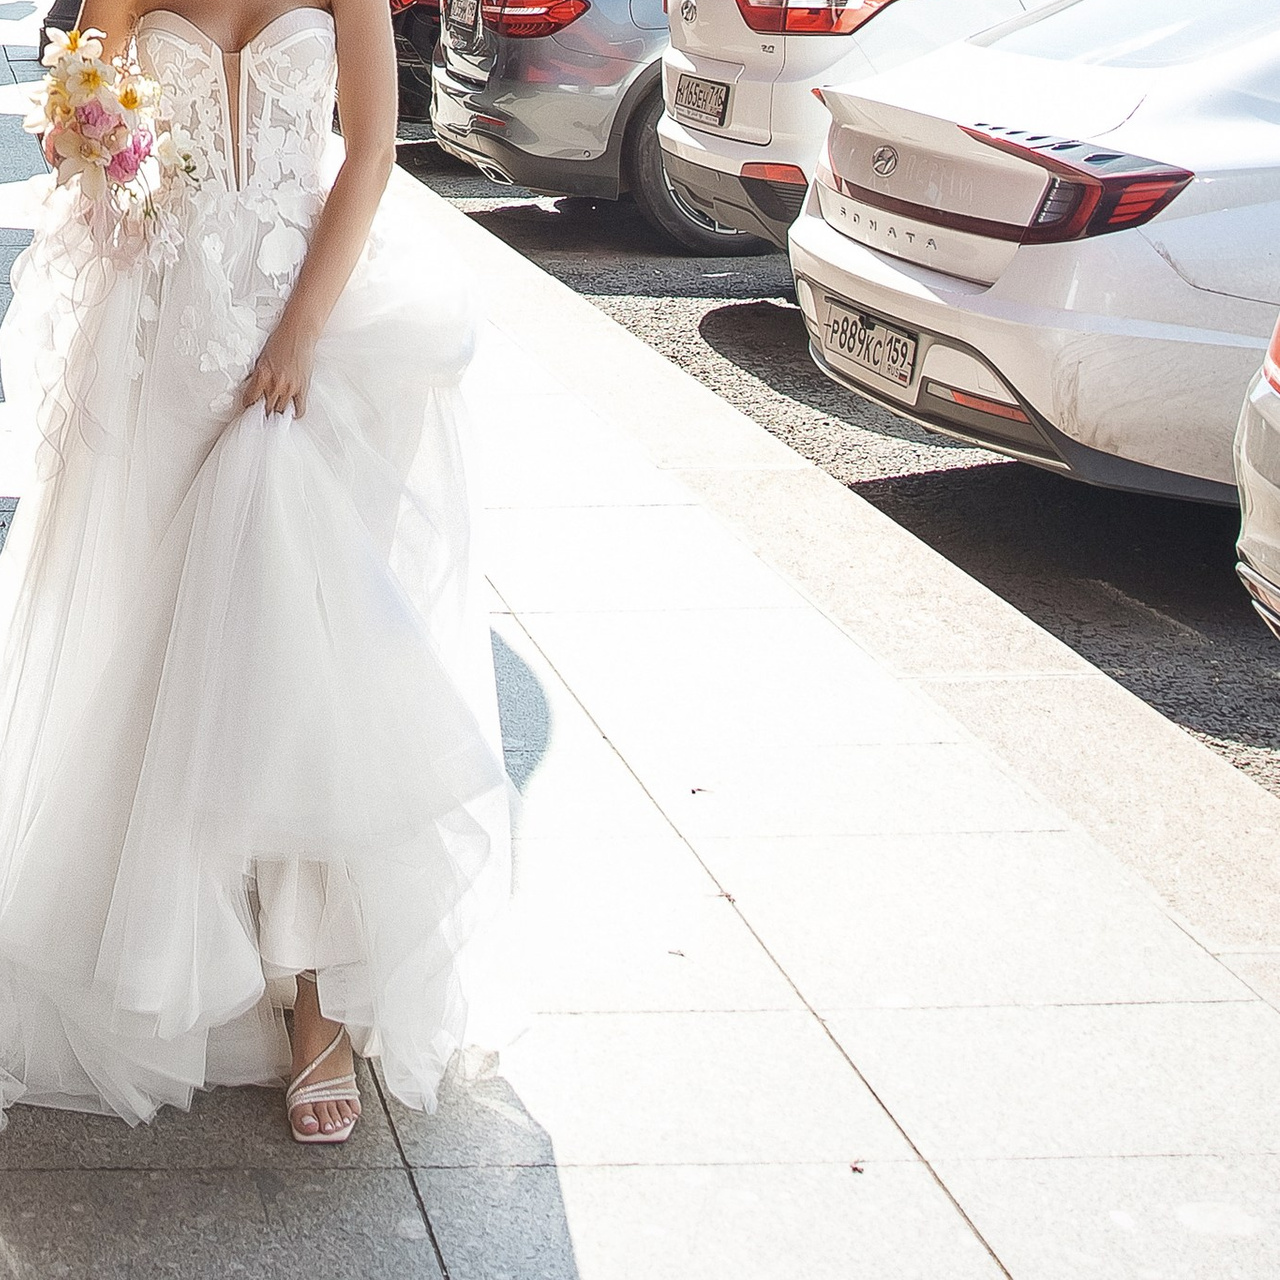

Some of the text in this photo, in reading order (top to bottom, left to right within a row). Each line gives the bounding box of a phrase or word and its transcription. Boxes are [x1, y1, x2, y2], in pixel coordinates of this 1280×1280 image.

[840, 206, 937, 251] SONATA
[830, 316, 908, 368] P889KC 159
[887, 363, 899, 378] RUS
